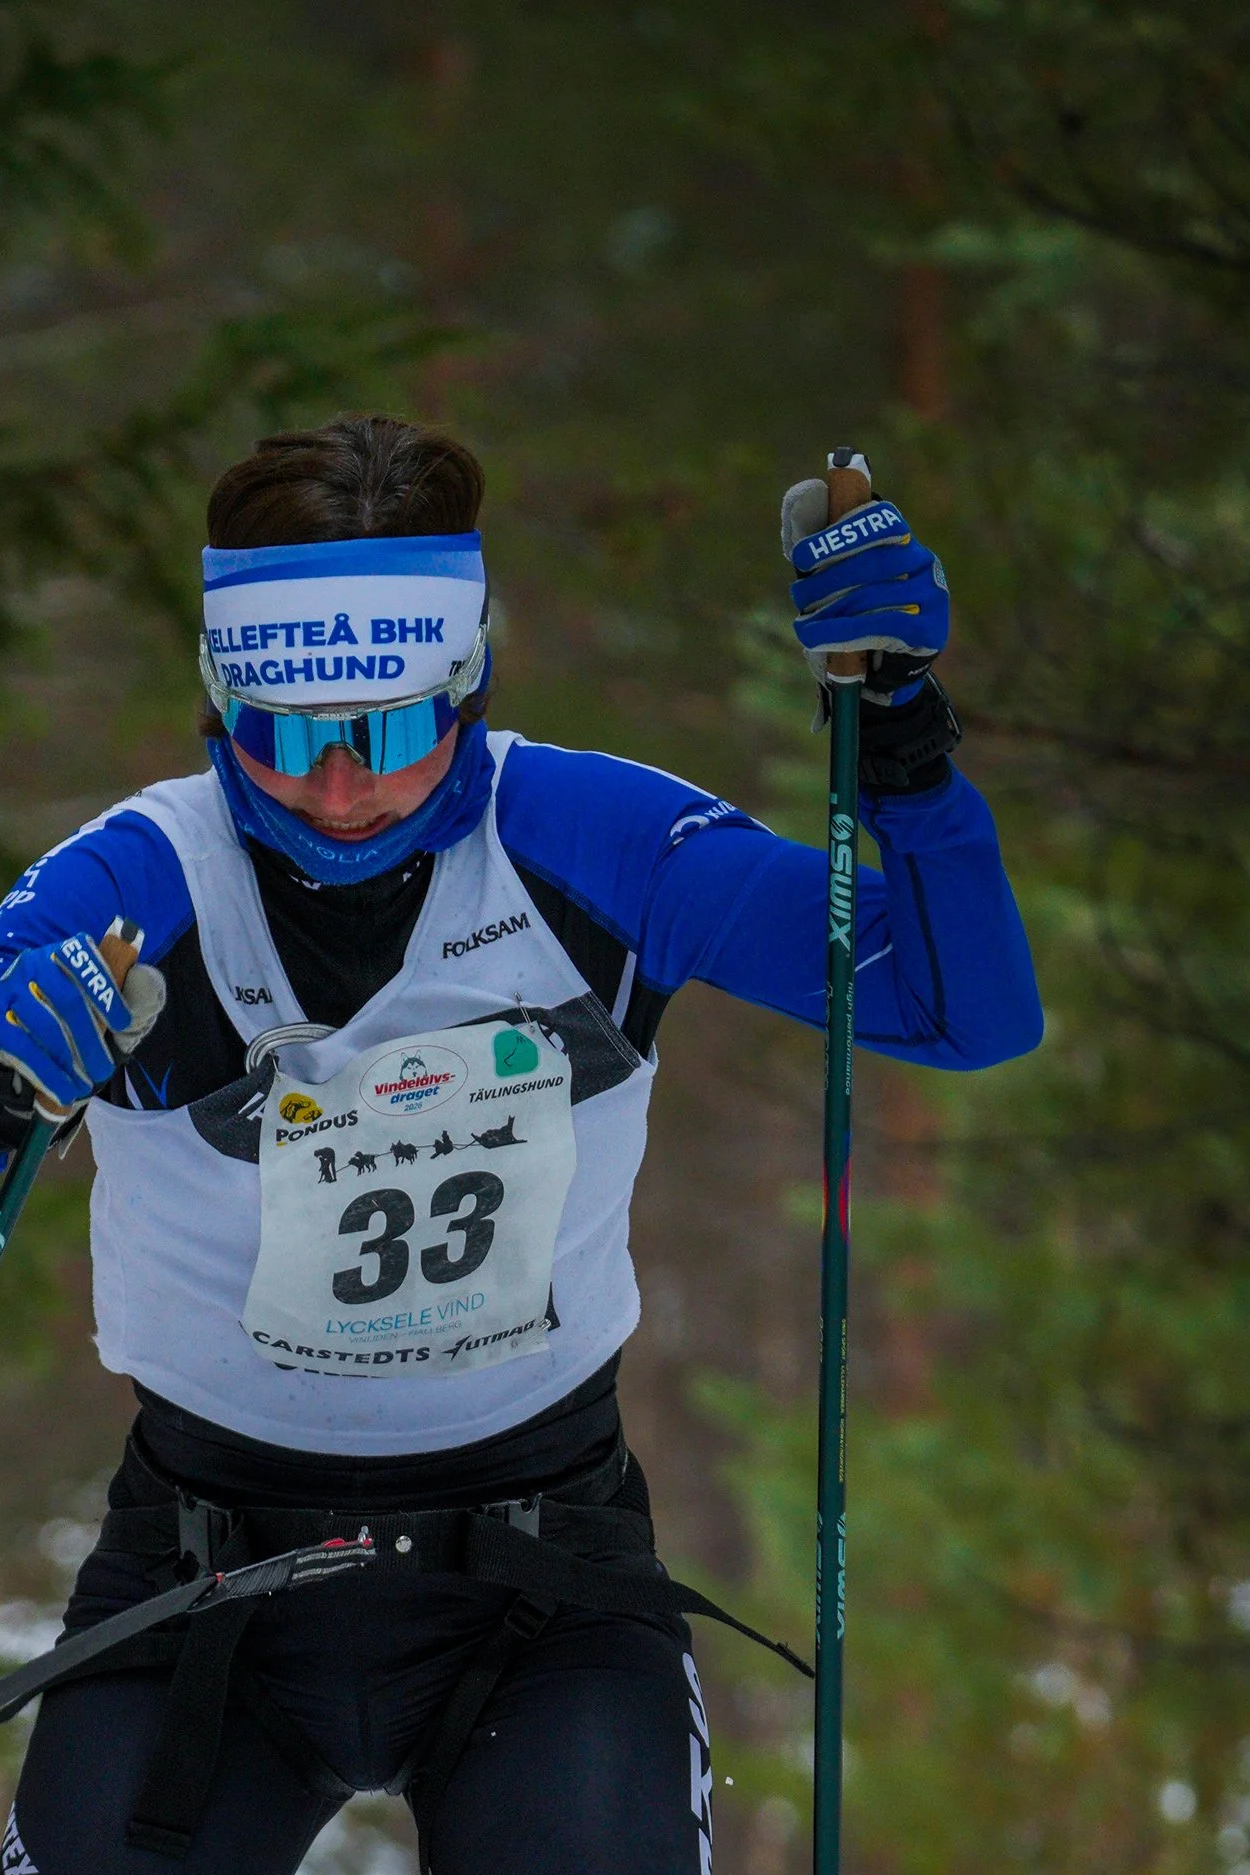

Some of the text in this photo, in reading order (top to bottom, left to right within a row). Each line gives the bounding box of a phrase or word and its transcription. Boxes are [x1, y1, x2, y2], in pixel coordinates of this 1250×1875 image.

[808, 508, 901, 560] HESTRA
[370, 617, 444, 643] BHK
[221, 655, 405, 688] DRAGHUND
[829, 840, 853, 952] SWIX
[442, 912, 531, 959] FOLKSAM
[60, 938, 115, 1013] ESTRA
[390, 1085, 440, 1104] draget
[469, 1076, 564, 1103] TÄVLINGSHUND
[275, 1109, 358, 1142] PONDUS
[332, 1170, 504, 1305] 33
[326, 1292, 485, 1335] LYCKSELE VIND
[252, 1331, 430, 1365] CARSTEDTS
